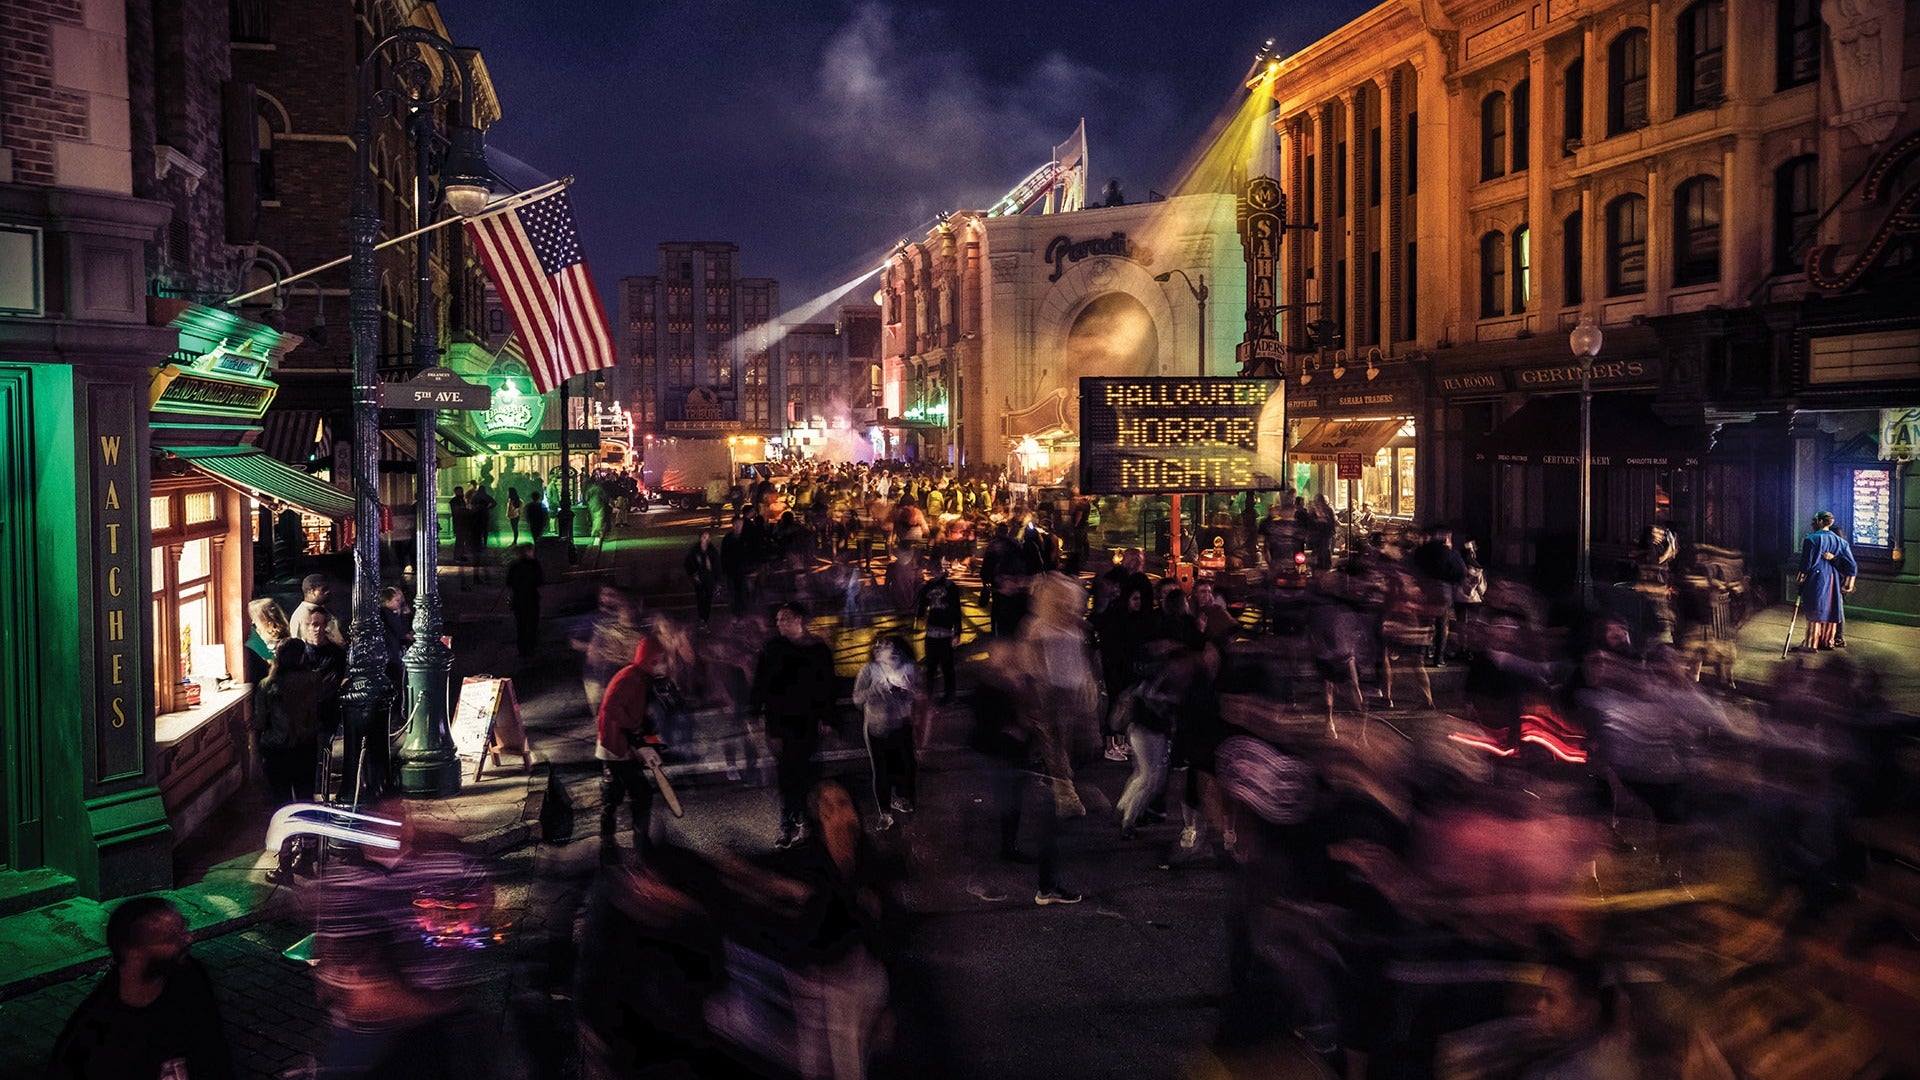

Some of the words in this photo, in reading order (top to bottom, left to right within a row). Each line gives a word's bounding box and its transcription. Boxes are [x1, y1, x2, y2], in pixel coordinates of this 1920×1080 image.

[1244, 340, 1286, 356] TADERS
[1443, 379, 1462, 390] TEA
[1464, 375, 1495, 388] ROOM
[414, 391, 431, 401] 5TH
[435, 391, 464, 402] AVE.
[1106, 384, 1267, 406] HALLOWEEN
[1339, 396, 1362, 405] SAHARA
[1364, 394, 1393, 404] TRADERS
[1118, 417, 1255, 446] HORROR
[541, 442, 560, 450] HOTEL
[1122, 457, 1251, 488] NIGHTS
[101, 436, 125, 728] WATCHES
